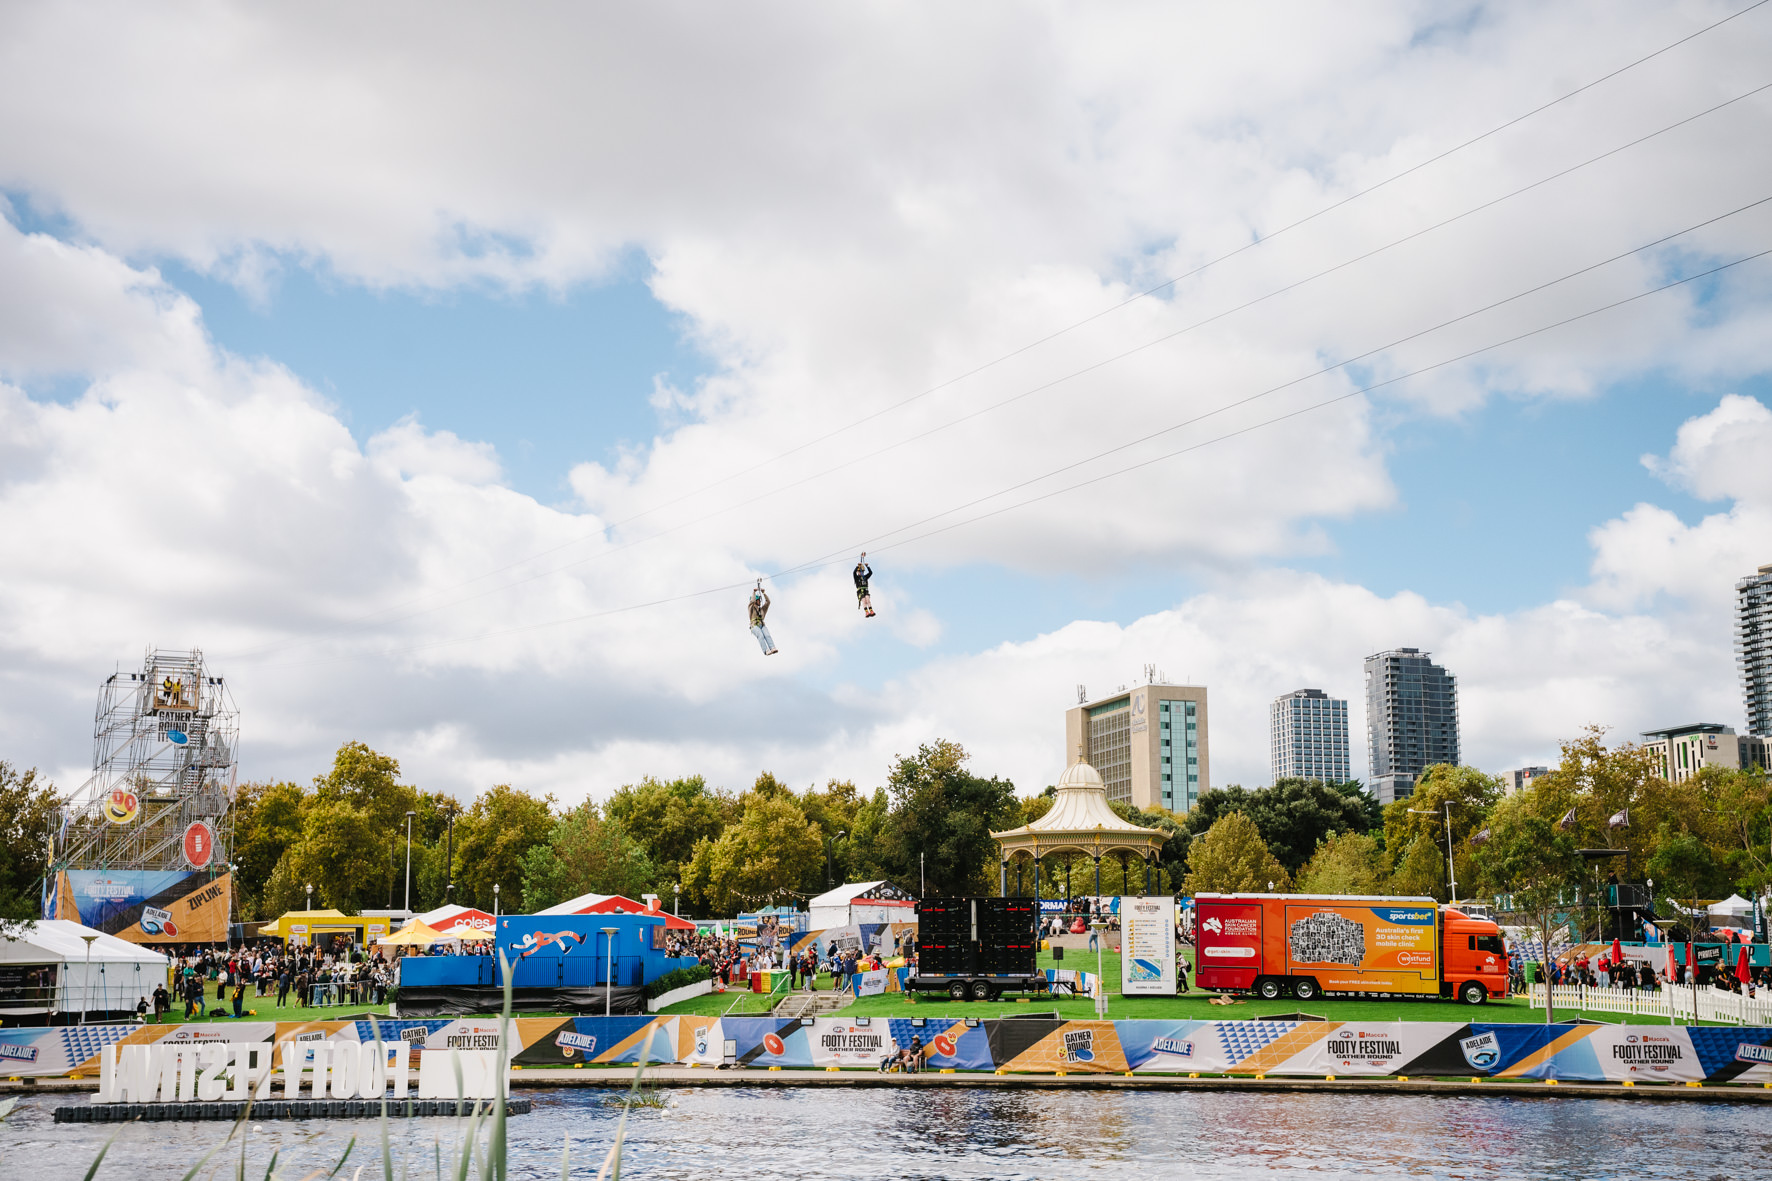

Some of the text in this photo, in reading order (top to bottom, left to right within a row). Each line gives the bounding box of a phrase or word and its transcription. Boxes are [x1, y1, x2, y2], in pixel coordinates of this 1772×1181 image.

[159, 711, 191, 721] GATHER
[158, 722, 187, 732] ROUND
[187, 883, 224, 911] ZIPLINE
[146, 908, 169, 919] ADELAIDE
[1389, 912, 1428, 921] sportsbet
[454, 916, 490, 929] coles
[299, 1033, 323, 1041] ADELAIDE
[402, 1027, 427, 1040] GATHER
[558, 1032, 592, 1048] ADELAIDE
[1065, 1030, 1092, 1043] GATHER
[407, 1037, 426, 1046] OUND
[447, 1035, 500, 1048] FOOTY FESTIV
[821, 1034, 883, 1048] FOOTY FESTIVAL
[1066, 1040, 1091, 1052] ROUND
[1152, 1038, 1190, 1054] ADELAIDE
[1327, 1040, 1402, 1054] FOOTY FESTIVAL
[1465, 1035, 1493, 1049] ADELAIDE
[0, 1044, 34, 1059] ADELAIDE
[1068, 1052, 1078, 1062] IT!
[1612, 1044, 1683, 1059] FOOTY FESTIVAL
